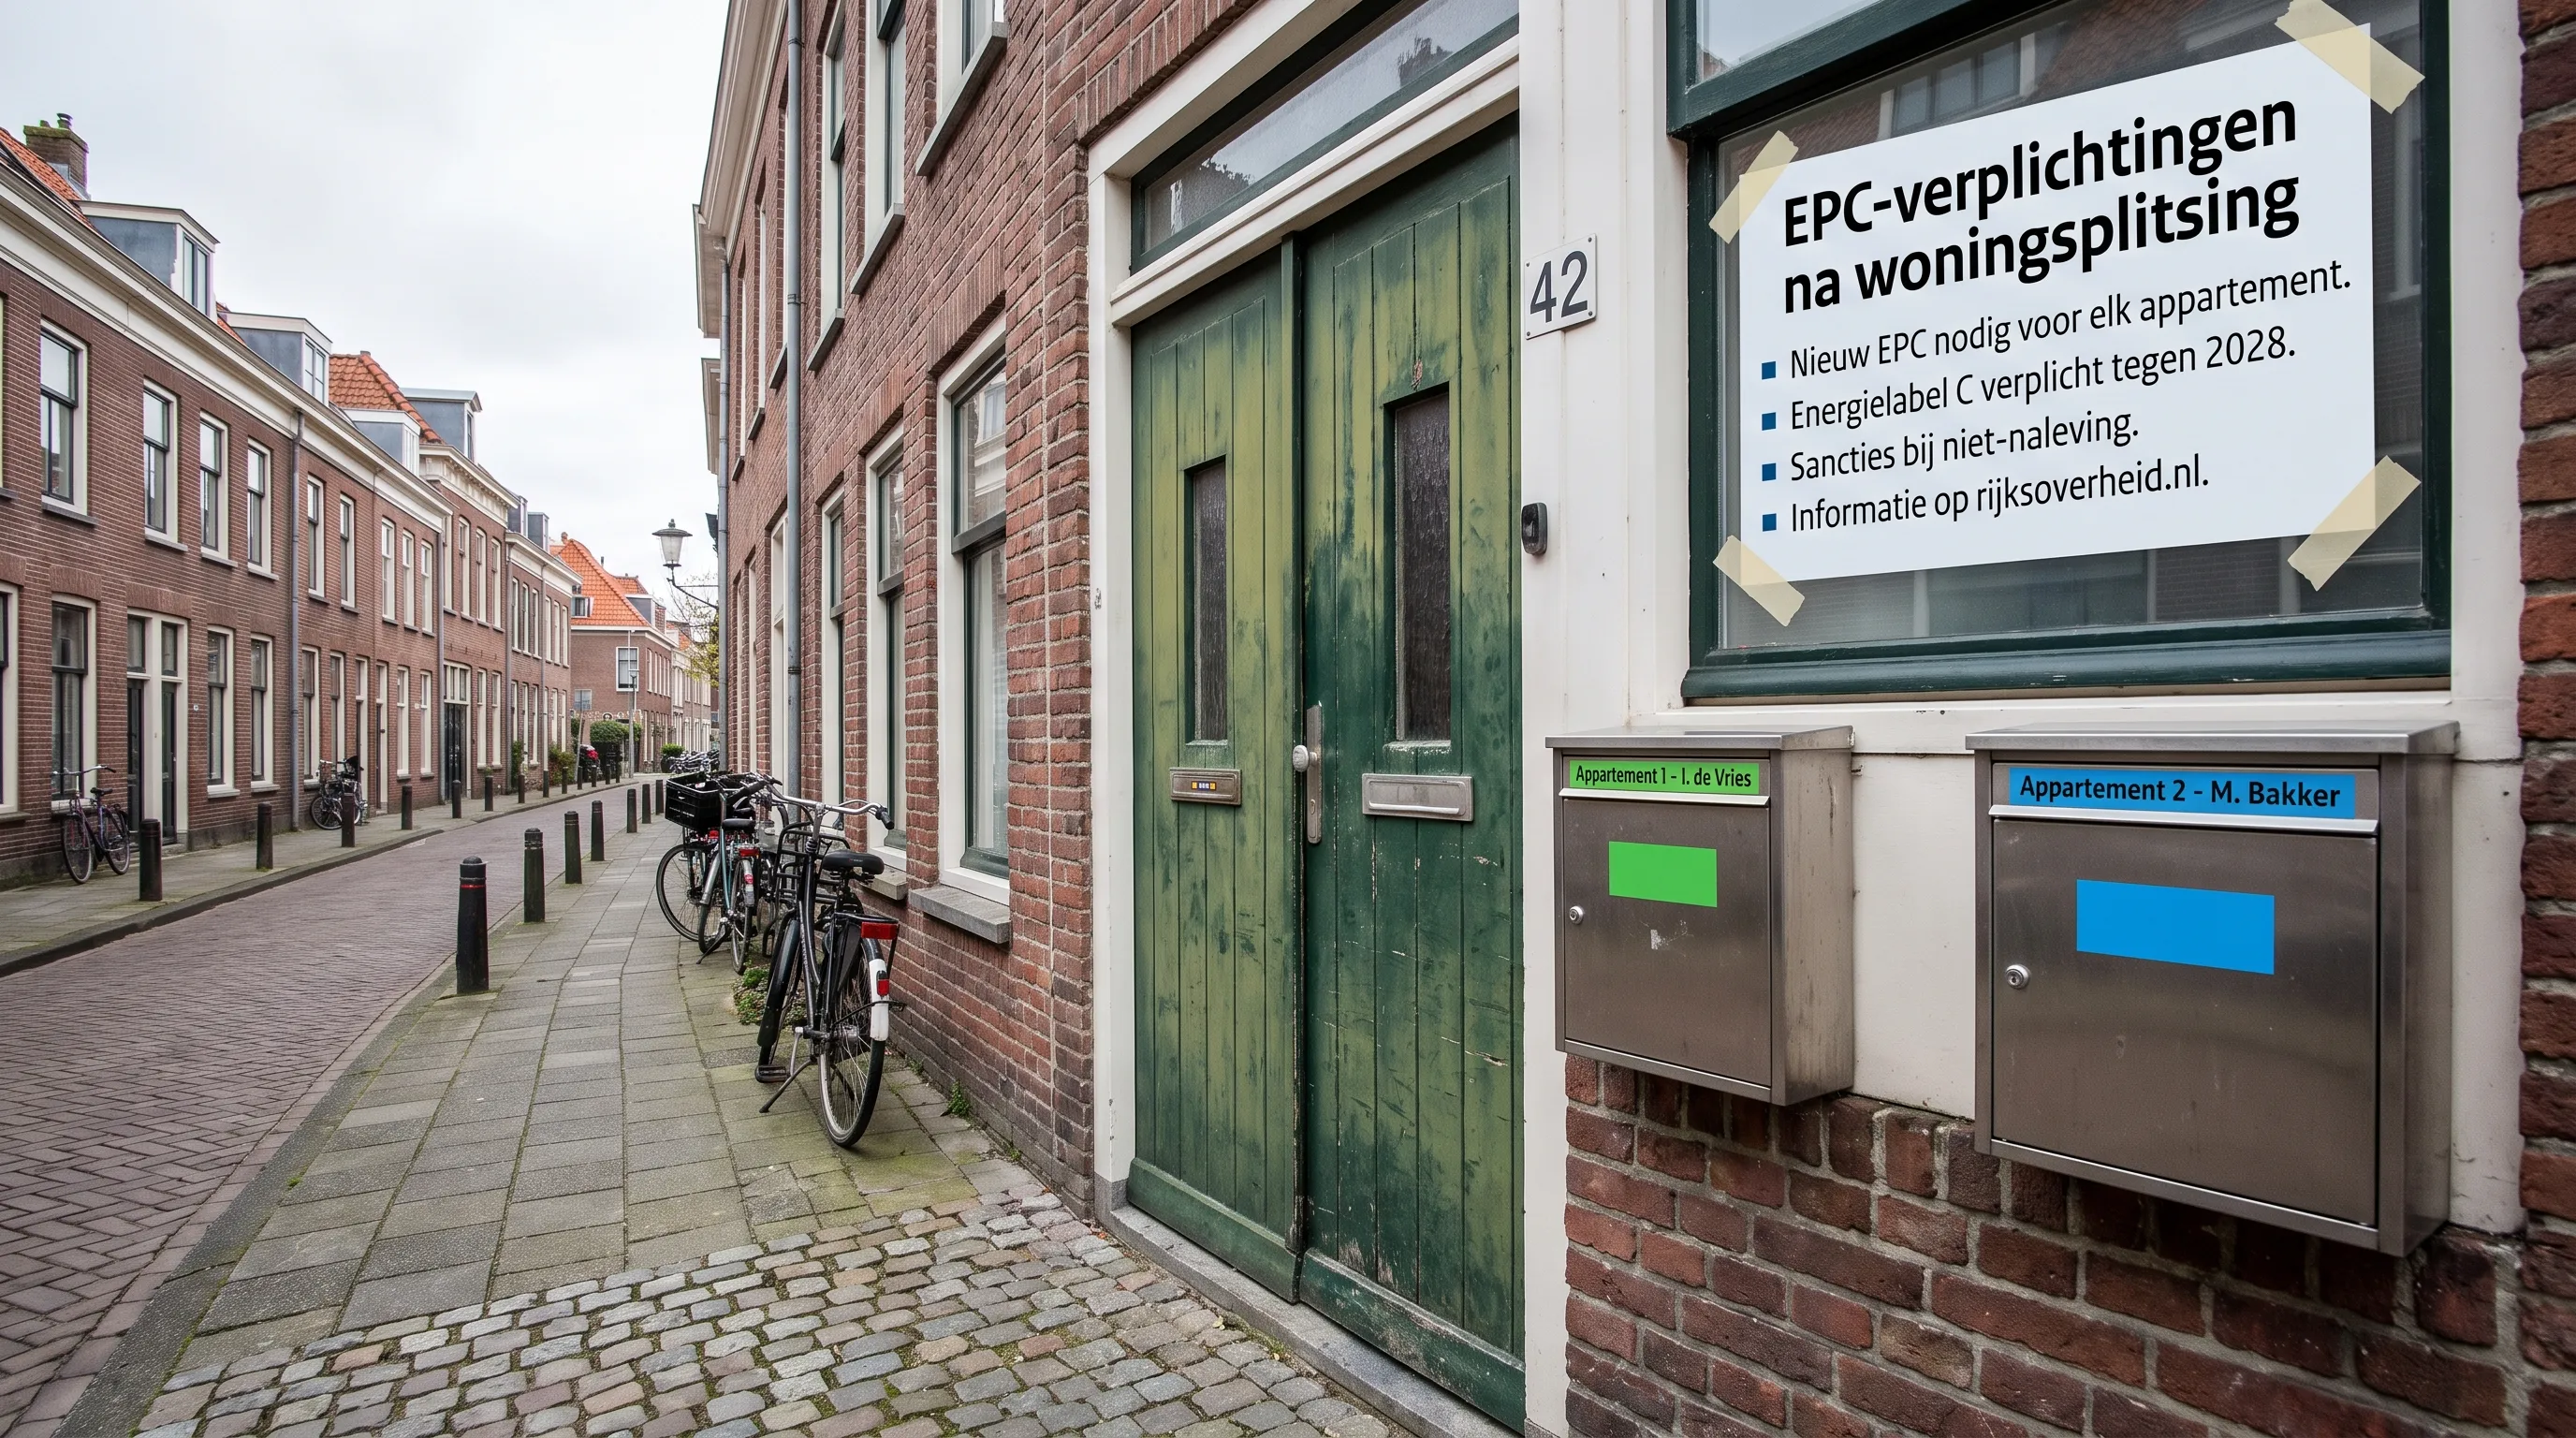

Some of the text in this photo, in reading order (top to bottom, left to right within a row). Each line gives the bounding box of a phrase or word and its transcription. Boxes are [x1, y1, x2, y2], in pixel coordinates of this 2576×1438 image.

[1785, 100, 2296, 247] EPC-verplichtingen
[1785, 176, 2300, 315] na woningsplitsing
[1530, 250, 1588, 323] 42
[1791, 259, 2351, 379] Nieuw EPC nodig voor elk appartement.
[1792, 325, 2295, 430] Energielabel C verplicht tegen 2028.
[1791, 410, 2139, 481] Sancties bij niet-naleving.
[1792, 452, 2209, 532] Informatie op rijksoverheid.nl.
[1575, 765, 1658, 786] Appartement
[1661, 767, 1666, 785] 1
[1681, 767, 1690, 785] I.
[1693, 767, 1711, 786] de
[1714, 768, 1751, 787] Vries
[2019, 774, 2167, 803] Appartement
[2173, 779, 2186, 802] 2
[2211, 780, 2241, 804] M.
[2248, 781, 2341, 808] Bakker
